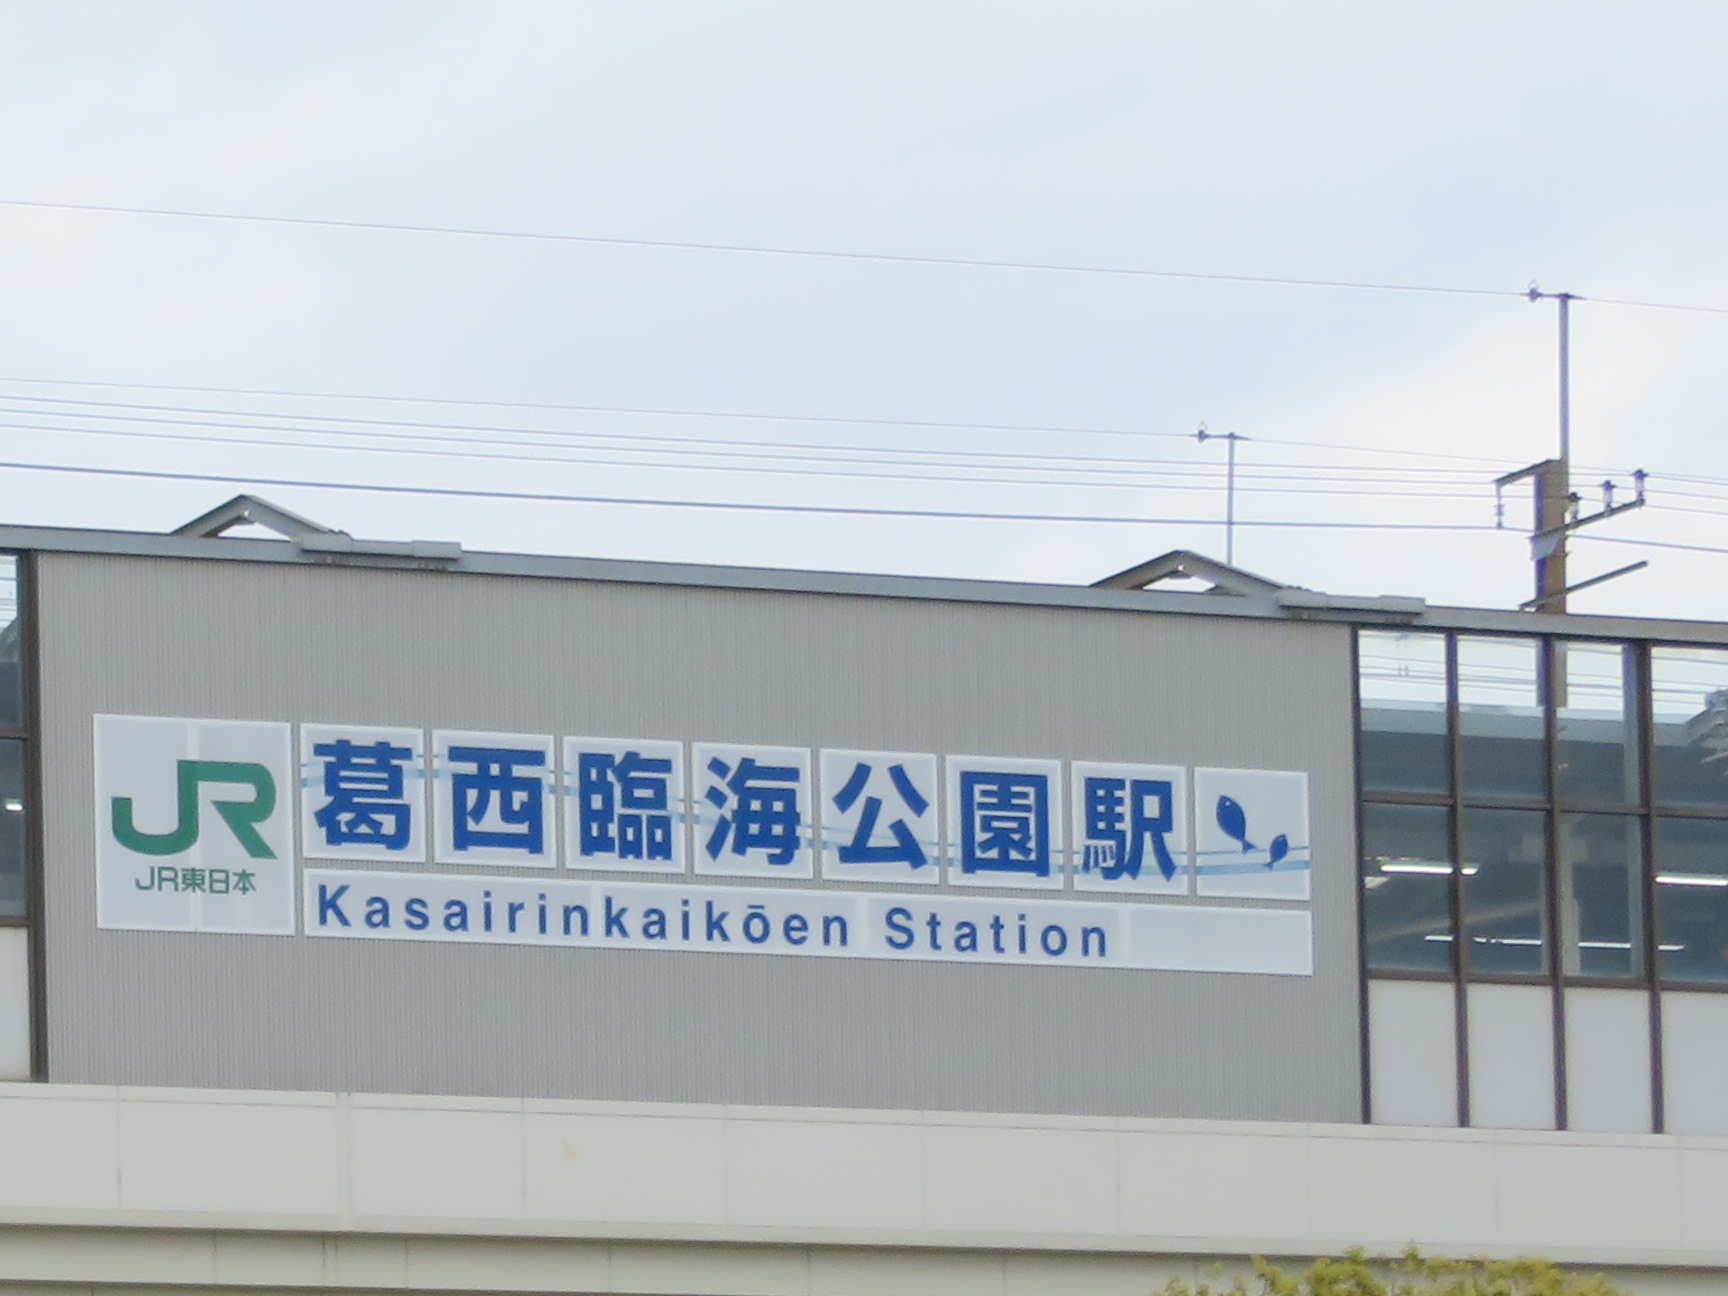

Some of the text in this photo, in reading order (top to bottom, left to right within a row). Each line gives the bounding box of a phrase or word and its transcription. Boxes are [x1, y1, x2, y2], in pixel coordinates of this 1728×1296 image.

[111, 759, 277, 860] JR
[312, 739, 1178, 882] 葛西臨海公園駅
[135, 865, 257, 895] JR東日本
[317, 884, 1107, 958] Kasairinkaikōen Station
